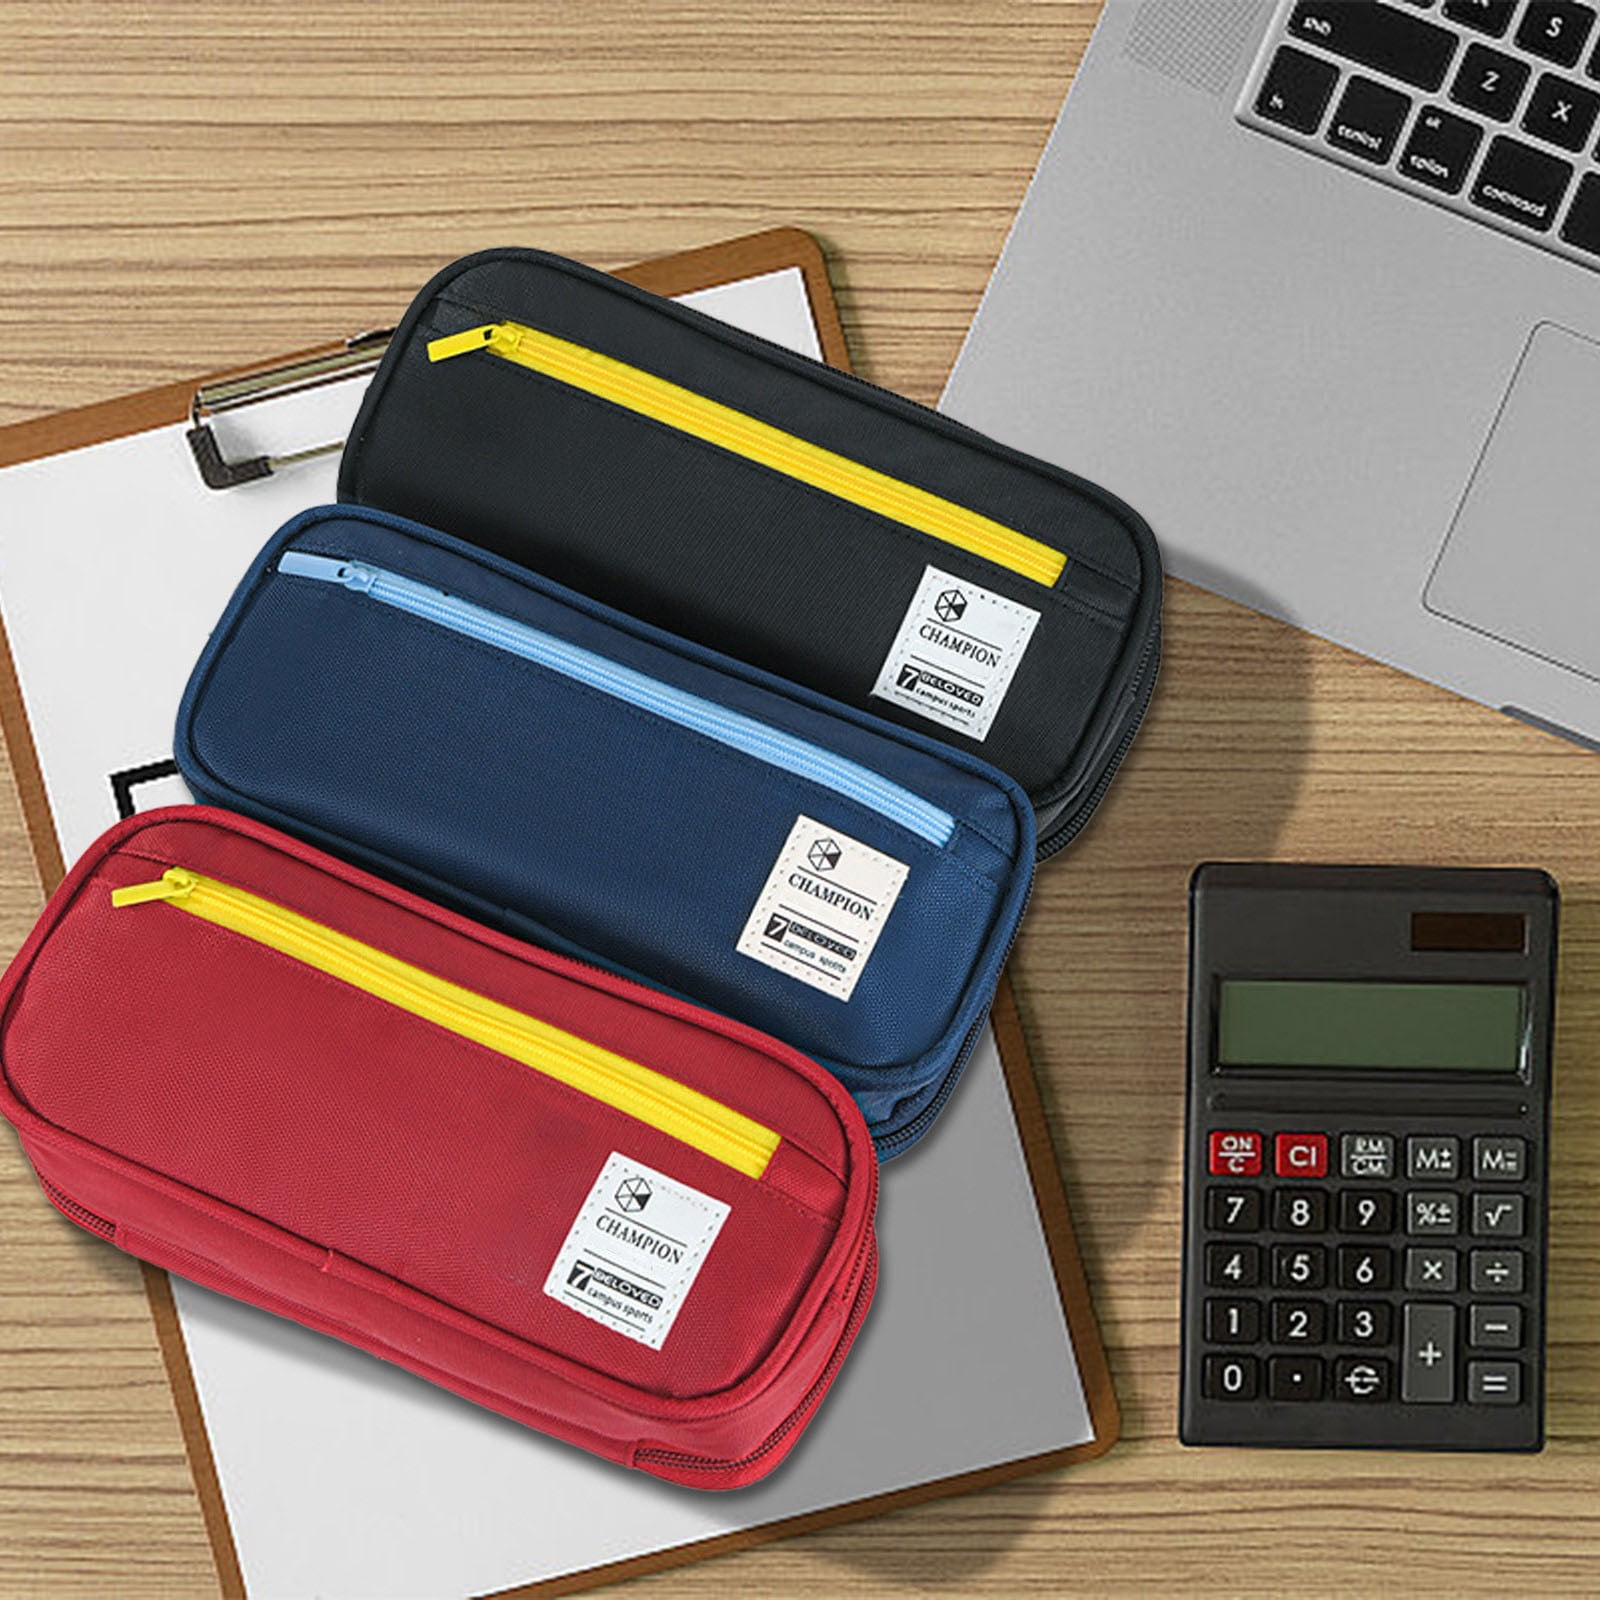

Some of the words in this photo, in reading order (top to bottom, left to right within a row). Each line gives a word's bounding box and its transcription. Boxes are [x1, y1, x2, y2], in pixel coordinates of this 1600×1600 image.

[1545, 17, 1563, 37] S
[1481, 71, 1499, 91] Z
[1552, 100, 1572, 122] X
[919, 623, 1001, 668] CHAMPION
[788, 873, 874, 921] CHAMPION
[1221, 1136, 1252, 1151] ON
[1228, 1158, 1244, 1172] C
[1227, 1197, 1245, 1224] 7
[1290, 1200, 1310, 1226] 8
[1358, 1200, 1375, 1226] 9
[596, 1215, 684, 1264] CHAMPION
[1223, 1254, 1242, 1280] 4
[1290, 1254, 1310, 1281] 5
[1356, 1256, 1374, 1283] 6
[1229, 1308, 1238, 1334] 1
[1289, 1311, 1308, 1337] 2
[1354, 1311, 1373, 1338] 3
[1223, 1365, 1242, 1391] 0
